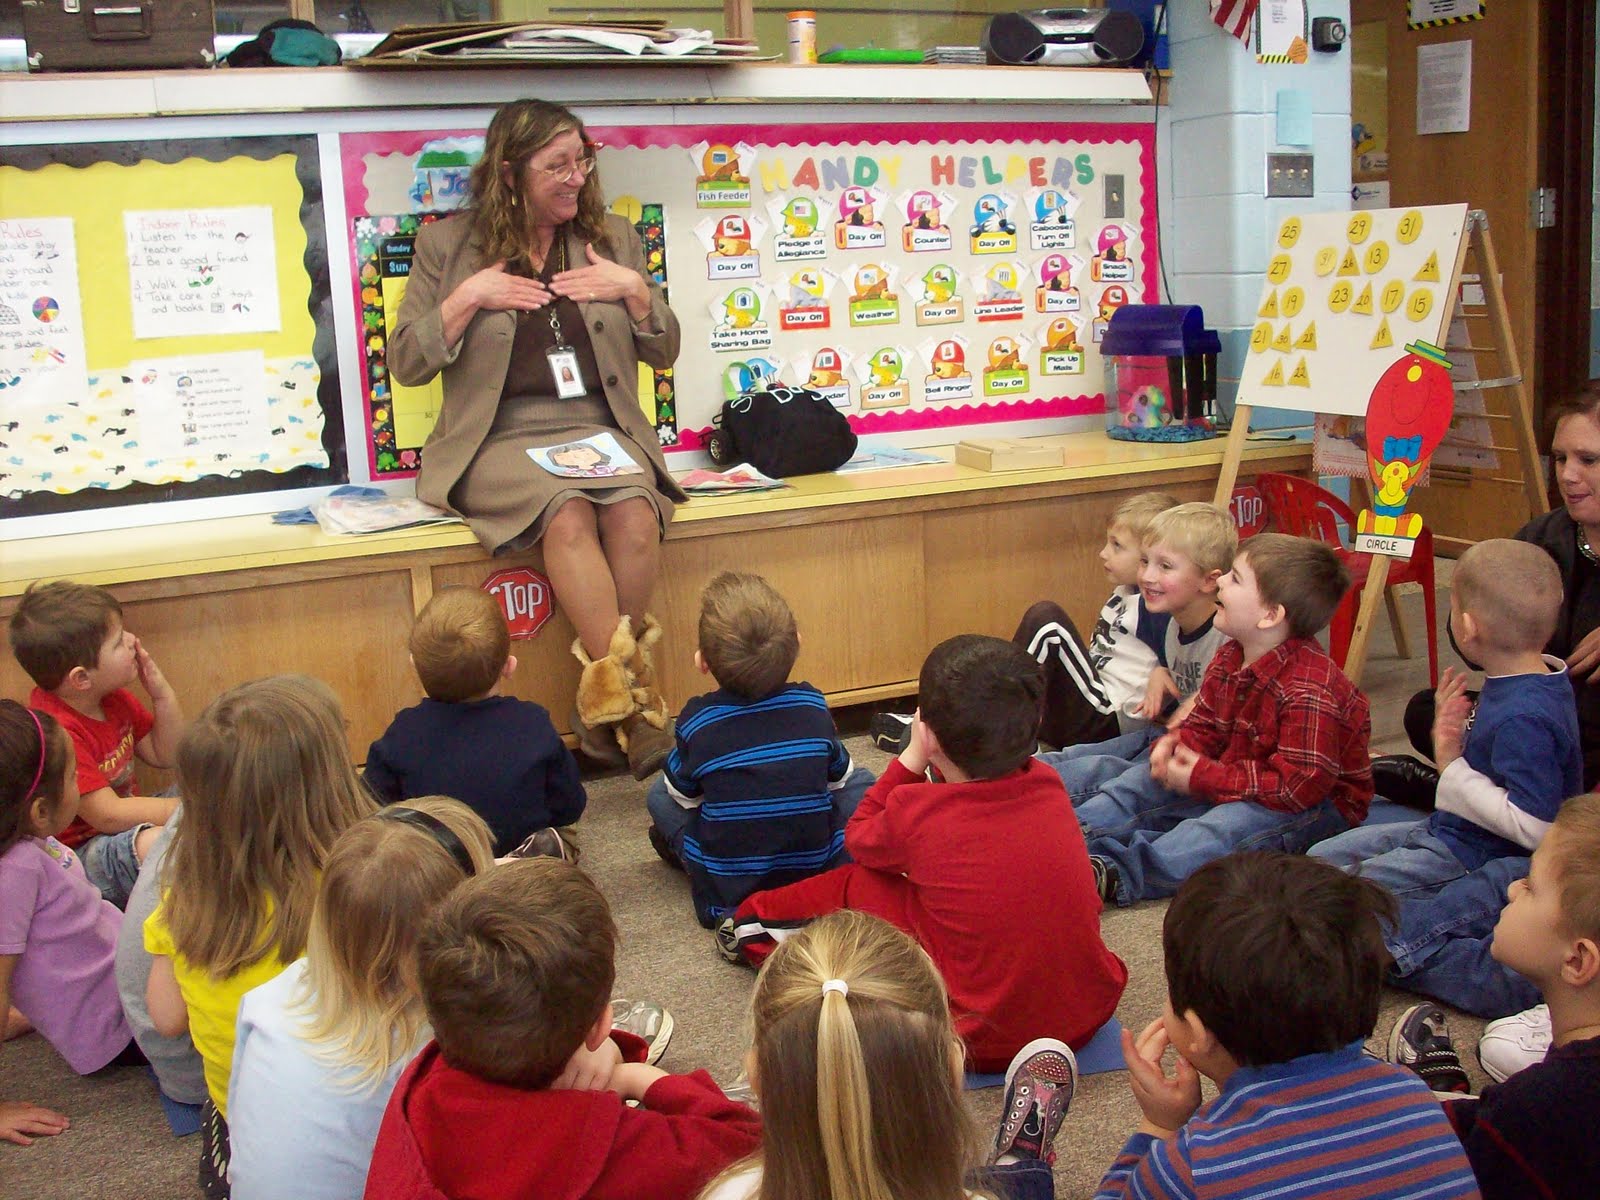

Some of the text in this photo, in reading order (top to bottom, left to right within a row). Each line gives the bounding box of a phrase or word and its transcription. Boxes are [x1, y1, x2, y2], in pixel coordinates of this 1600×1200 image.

[759, 153, 1095, 192] HANDY HELPERS
[699, 191, 749, 201] Fish Feeder
[1349, 220, 1366, 235] 29
[1400, 217, 1416, 235] 31
[141, 232, 176, 242] Listen
[185, 232, 198, 240] to
[207, 230, 225, 239] the
[1281, 225, 1297, 239] 25
[778, 240, 811, 248] Pledge
[914, 235, 950, 244] Counter
[979, 240, 996, 248] Day
[143, 244, 182, 254] teacher
[386, 244, 411, 253] Sunday
[777, 249, 825, 258] Allegiance
[146, 256, 161, 266] Be
[180, 253, 209, 269] good
[217, 251, 249, 262] friend
[1369, 248, 1382, 263] 13
[389, 261, 408, 273] Sun
[1102, 263, 1127, 271] Snack
[1270, 261, 1287, 275] 27
[1342, 257, 1354, 269] 26
[1422, 262, 1436, 273] 24
[1102, 272, 1128, 280] Helper
[148, 279, 177, 290] Walk
[145, 291, 172, 302] Take
[179, 292, 202, 301] care
[210, 286, 222, 299] of
[1331, 287, 1349, 304] 23
[1356, 294, 1370, 305] 20
[1385, 289, 1399, 304] 17
[1287, 294, 1298, 308] 19
[1413, 298, 1426, 313] 15
[152, 303, 204, 314] and books
[944, 308, 957, 316] Off
[994, 304, 1025, 313] Leader
[787, 313, 822, 322] Day Off
[856, 310, 895, 320] Weather
[712, 328, 769, 339] Take Home
[1253, 330, 1266, 344] 21
[1303, 332, 1314, 343] 28
[1376, 327, 1387, 342] 18
[711, 338, 772, 349] Sharing Bag
[1278, 335, 1289, 345] 30
[1270, 366, 1280, 378] 16
[1293, 366, 1306, 378] 22
[944, 383, 972, 393] Ringer
[991, 378, 1023, 388] Day Off
[867, 390, 901, 400] Day Off
[1230, 495, 1263, 528] TOP
[1366, 537, 1397, 551] CIRCLE
[489, 581, 543, 620] TOP
